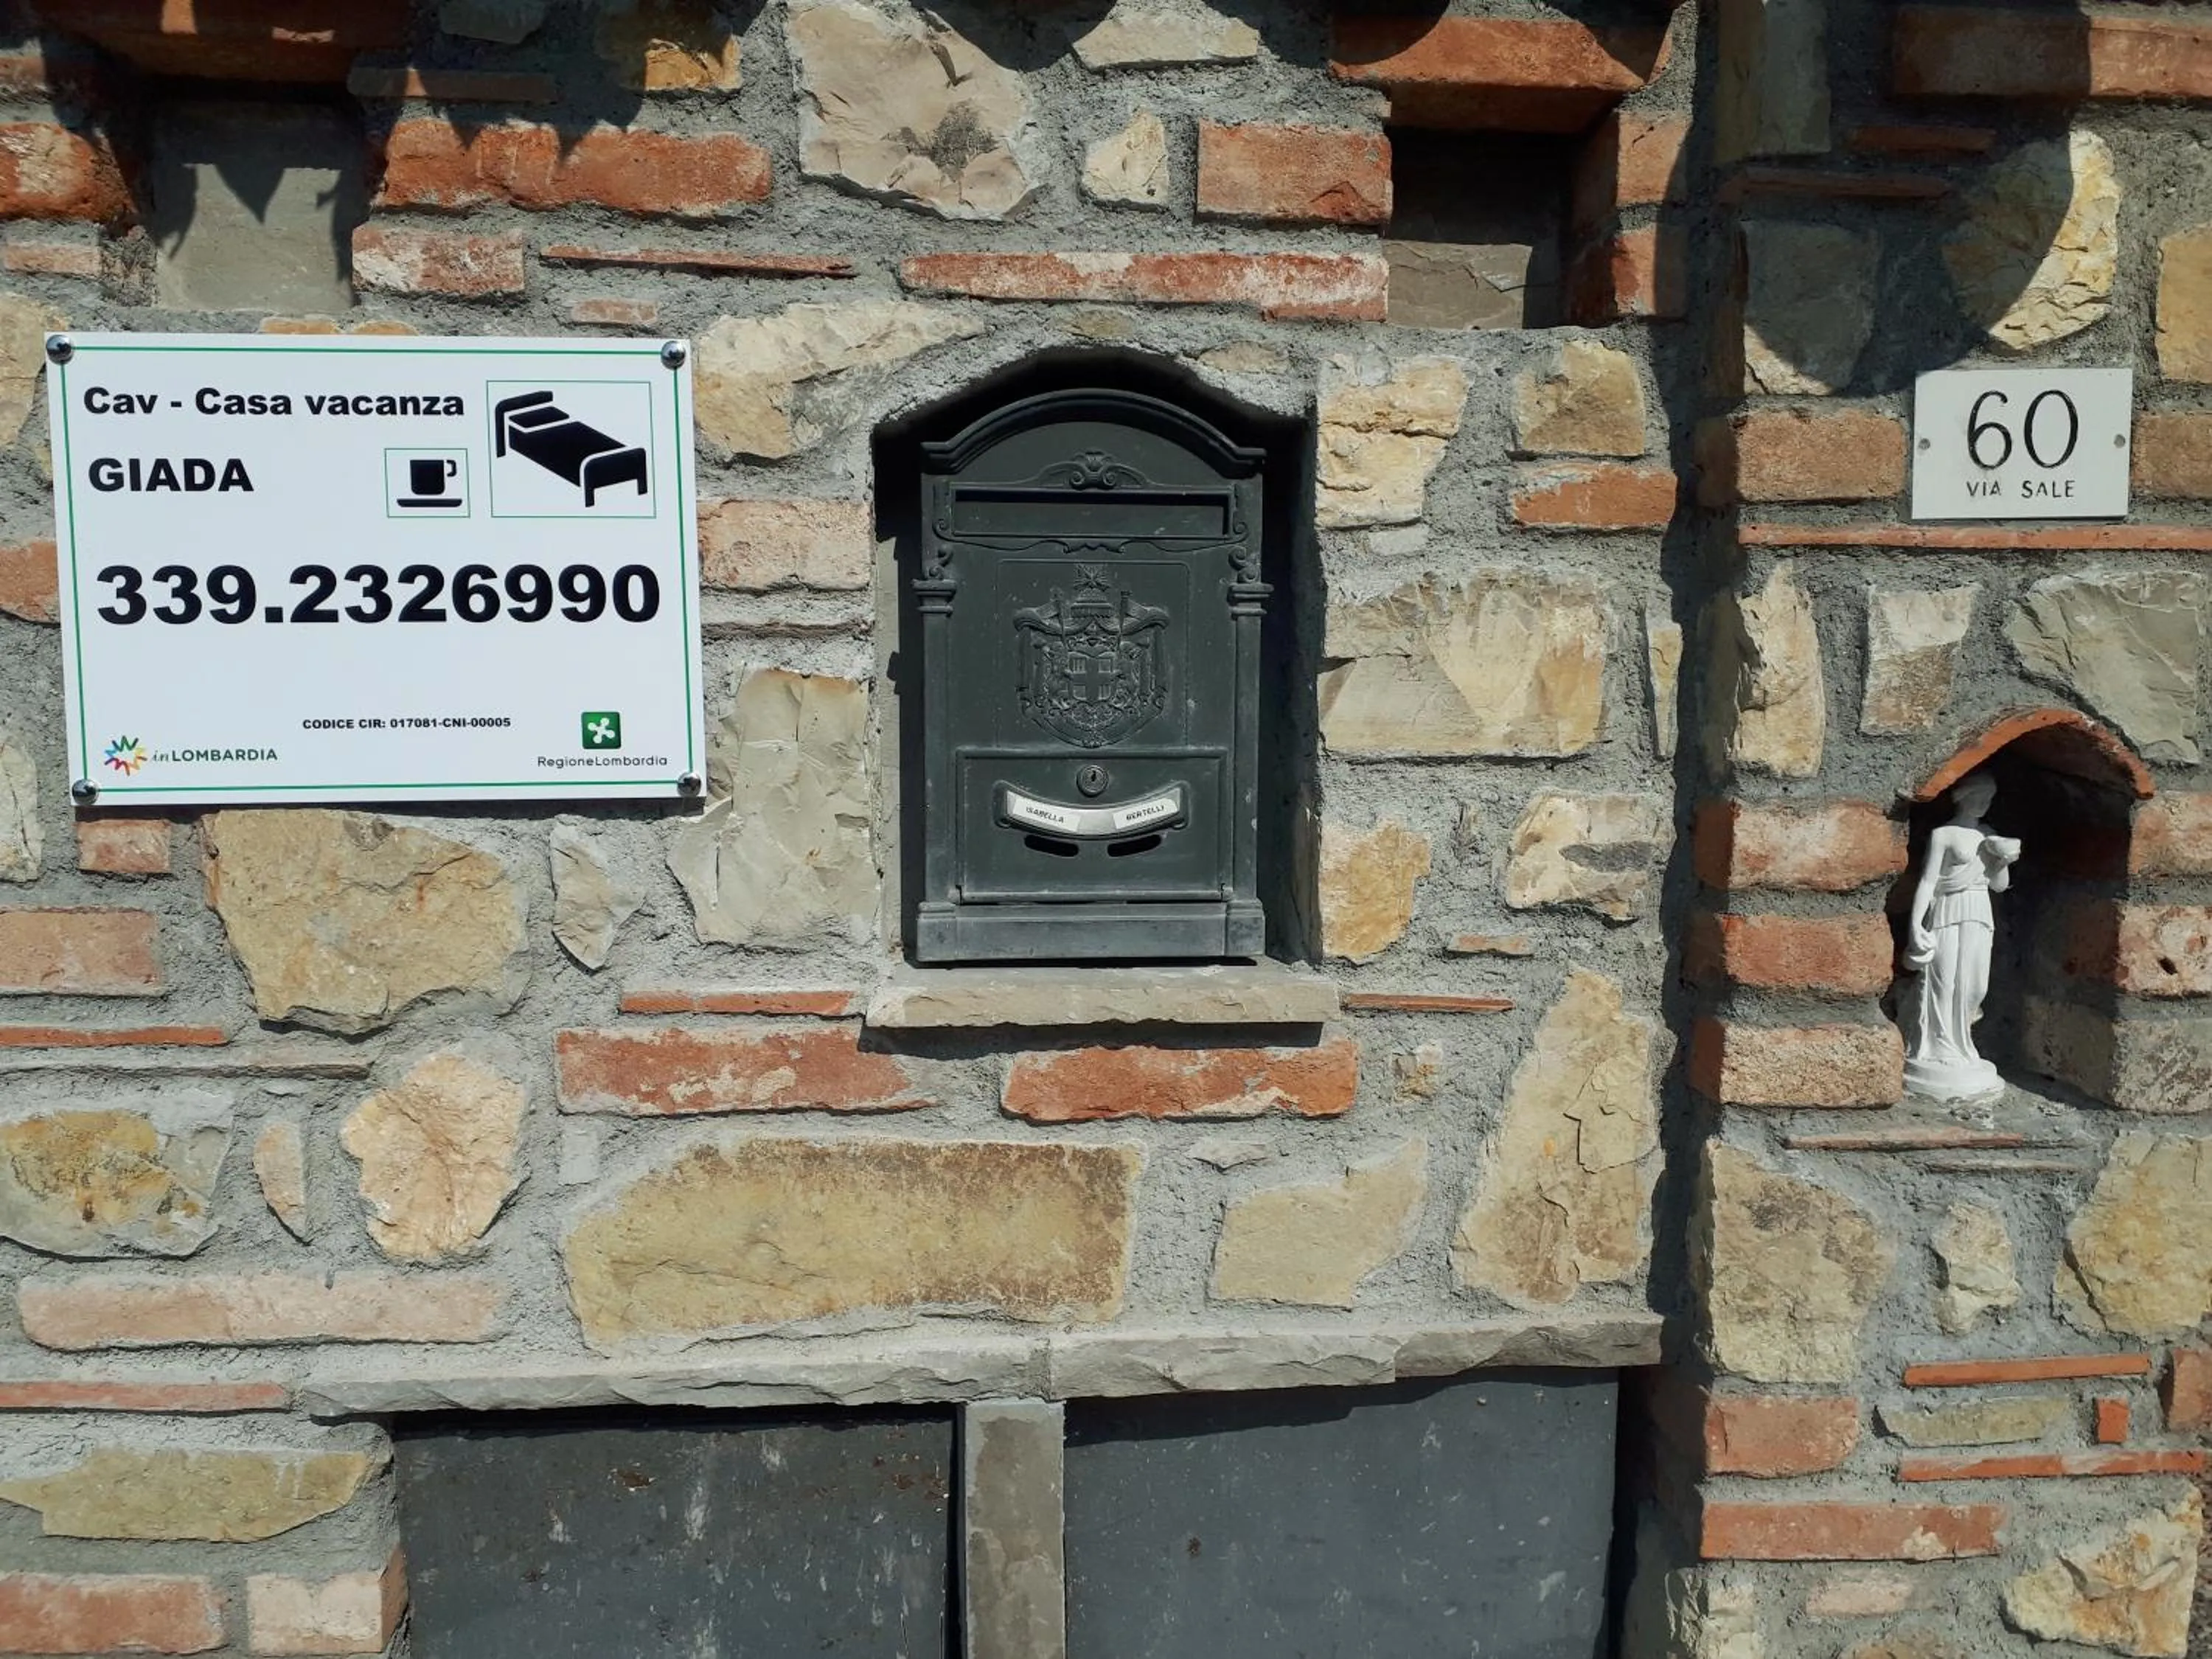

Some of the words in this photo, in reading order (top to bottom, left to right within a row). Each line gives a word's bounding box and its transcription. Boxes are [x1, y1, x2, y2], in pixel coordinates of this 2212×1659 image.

[83, 387, 158, 414] Cav
[195, 387, 292, 415] Casa
[305, 395, 465, 416] vacanza
[1967, 389, 2079, 470] 60
[88, 458, 254, 492] GIADA
[1966, 481, 2001, 498] VIA
[2021, 480, 2075, 499] SALE
[97, 564, 660, 625] 339.2326990
[302, 719, 355, 729] CODICE
[358, 719, 386, 729] CIR:
[390, 717, 511, 728] 017081-CNI-00005
[538, 755, 668, 769] RegioneLombardia
[1025, 806, 1065, 824] ISABELLA
[1125, 804, 1165, 821] BERTELLI
